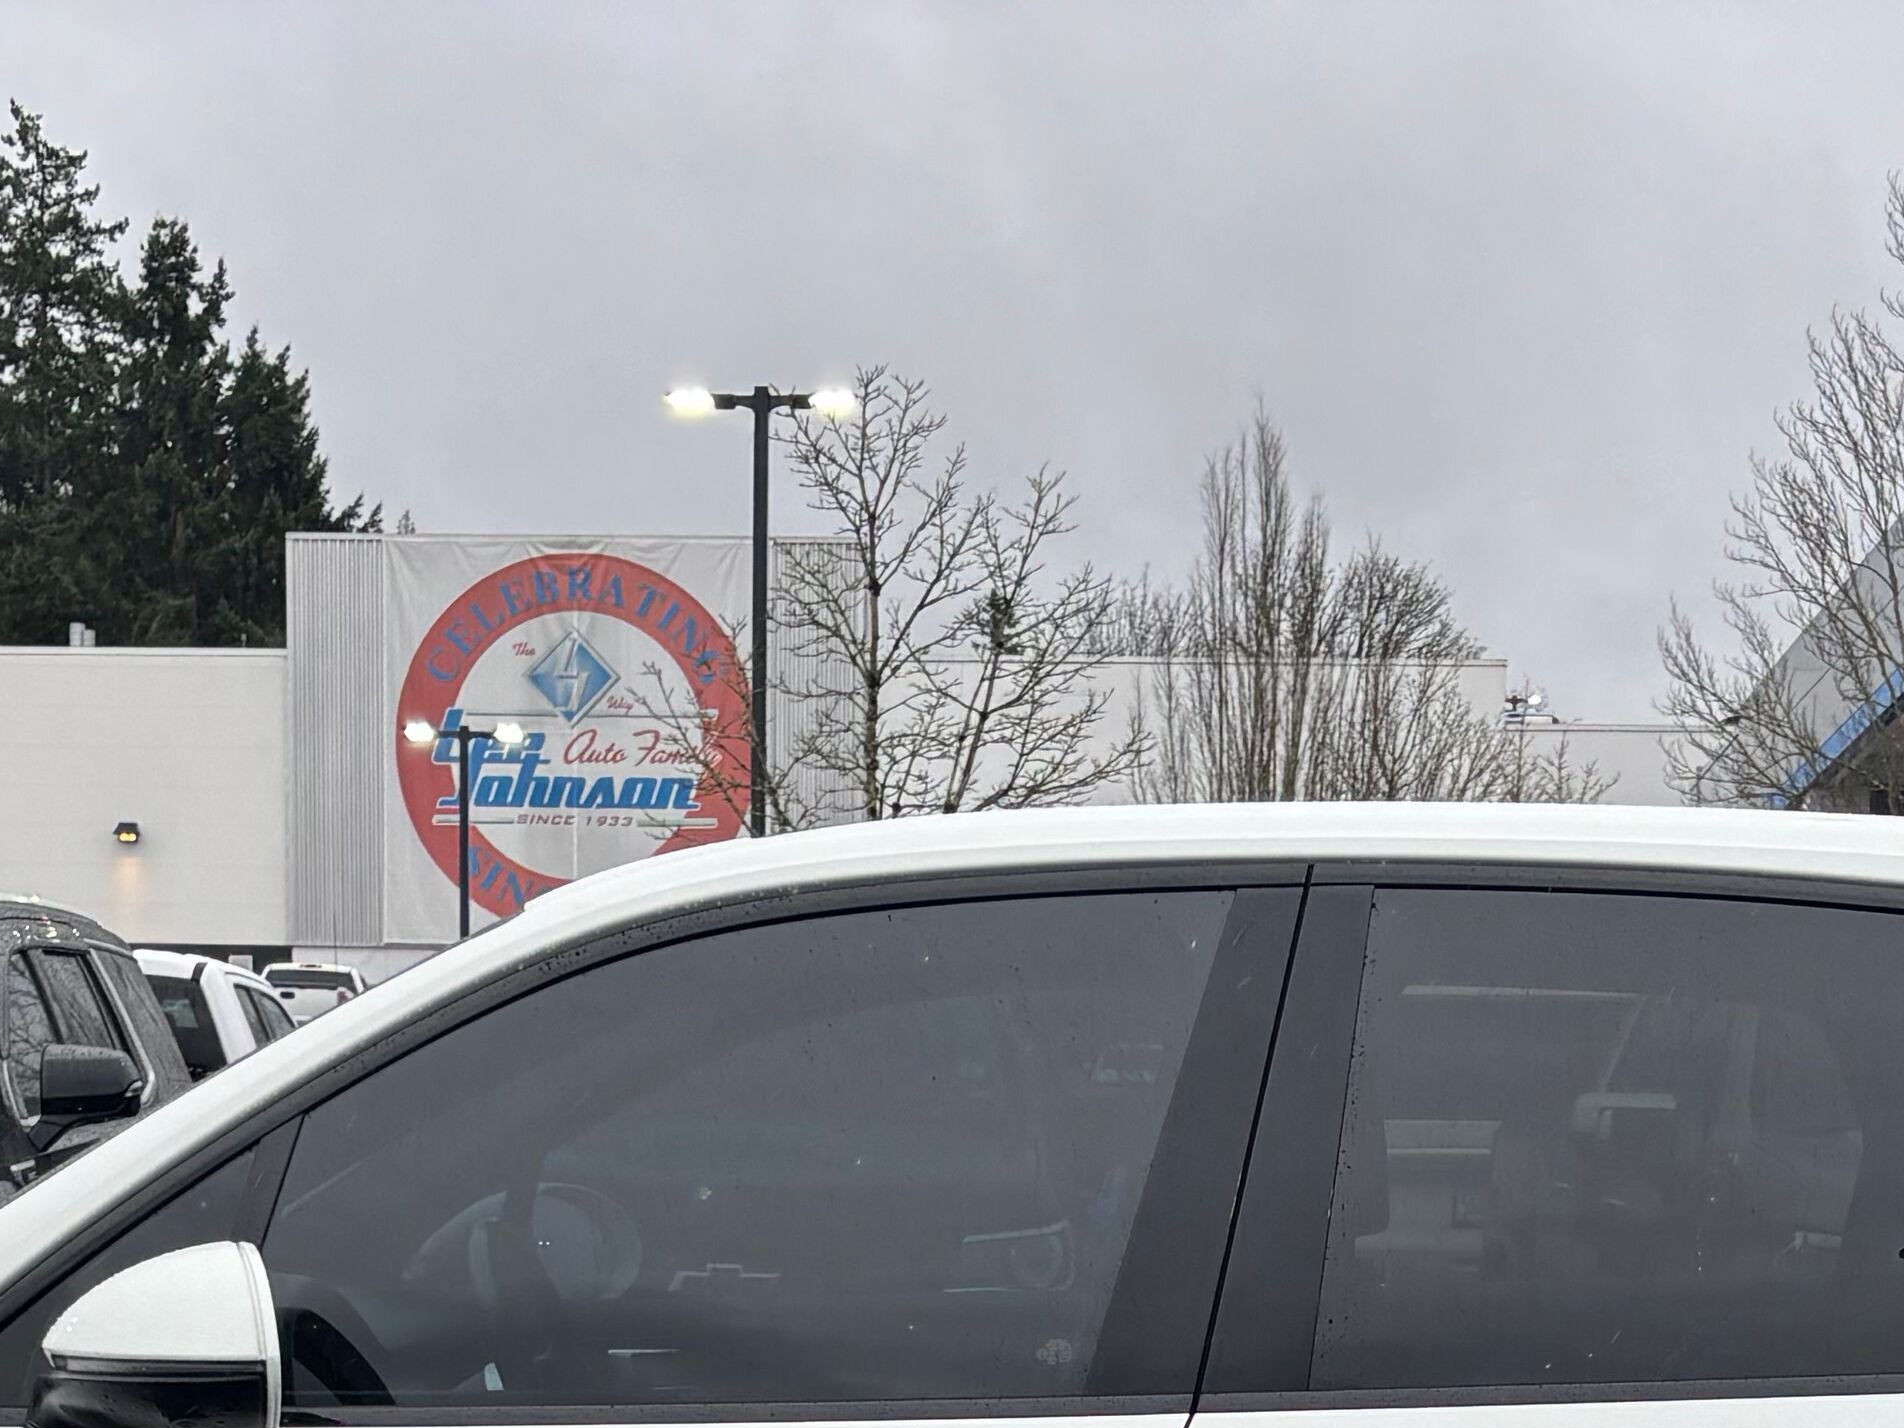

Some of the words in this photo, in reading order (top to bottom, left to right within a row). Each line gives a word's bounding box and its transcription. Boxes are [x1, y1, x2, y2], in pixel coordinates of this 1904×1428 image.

[425, 566, 720, 685] CELEBRATING
[512, 641, 536, 657] The
[606, 695, 634, 713] Way
[437, 740, 700, 808] Johnson
[563, 729, 628, 765] Auto
[516, 813, 575, 826] SINCE
[586, 815, 634, 827] 1933
